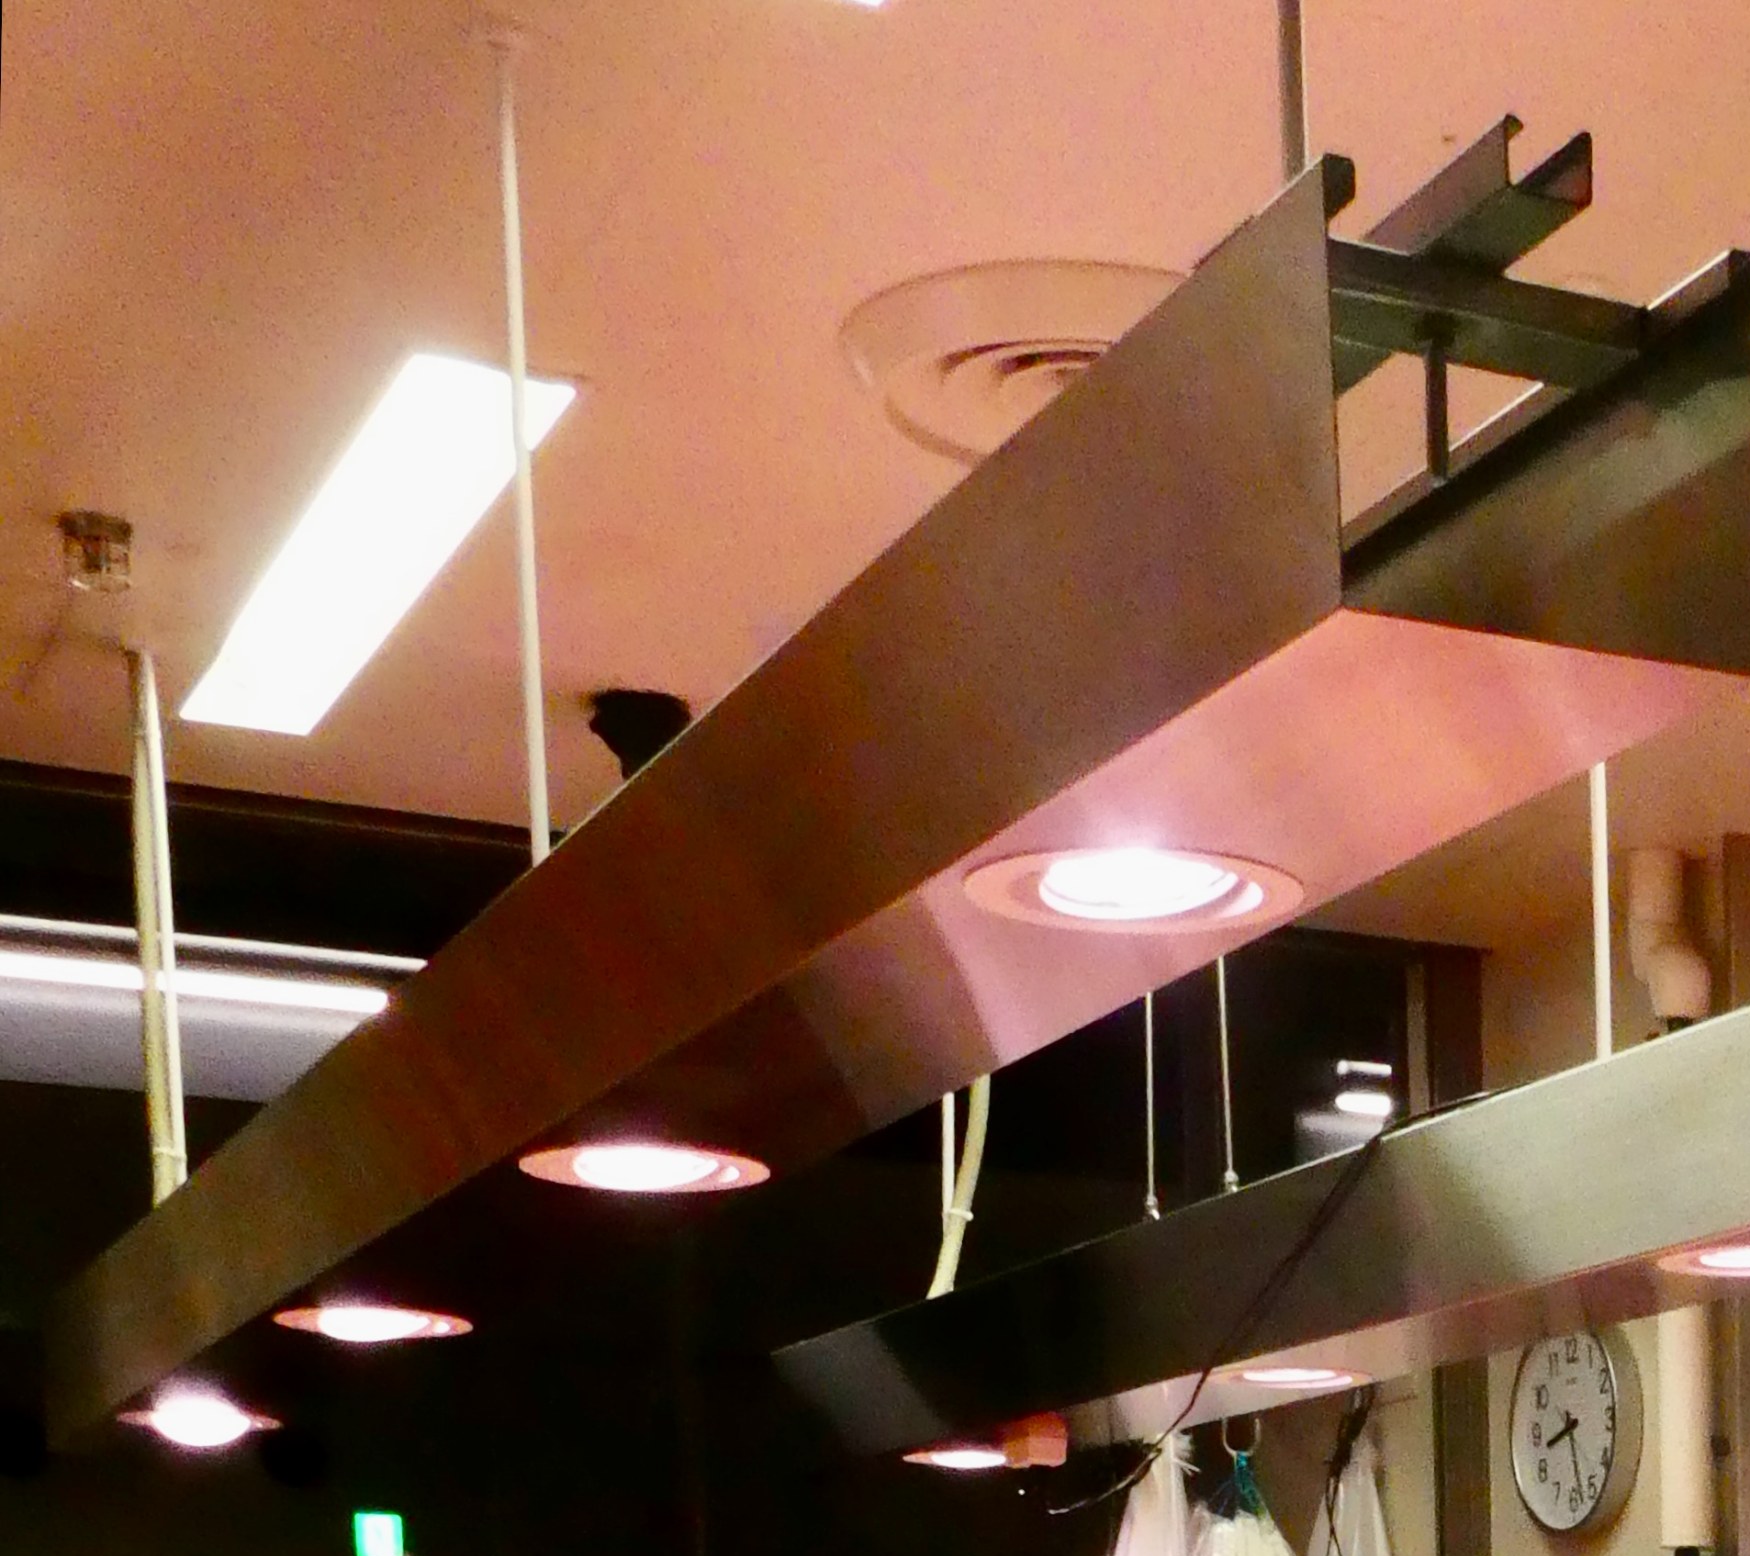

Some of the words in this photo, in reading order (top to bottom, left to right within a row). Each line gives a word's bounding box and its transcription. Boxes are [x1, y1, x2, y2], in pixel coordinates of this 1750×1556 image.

[1601, 1367, 1610, 1394] 2
[1538, 1458, 1548, 1483] 8
[1553, 1481, 1561, 1507] 7
[1588, 1475, 1597, 1500] 5
